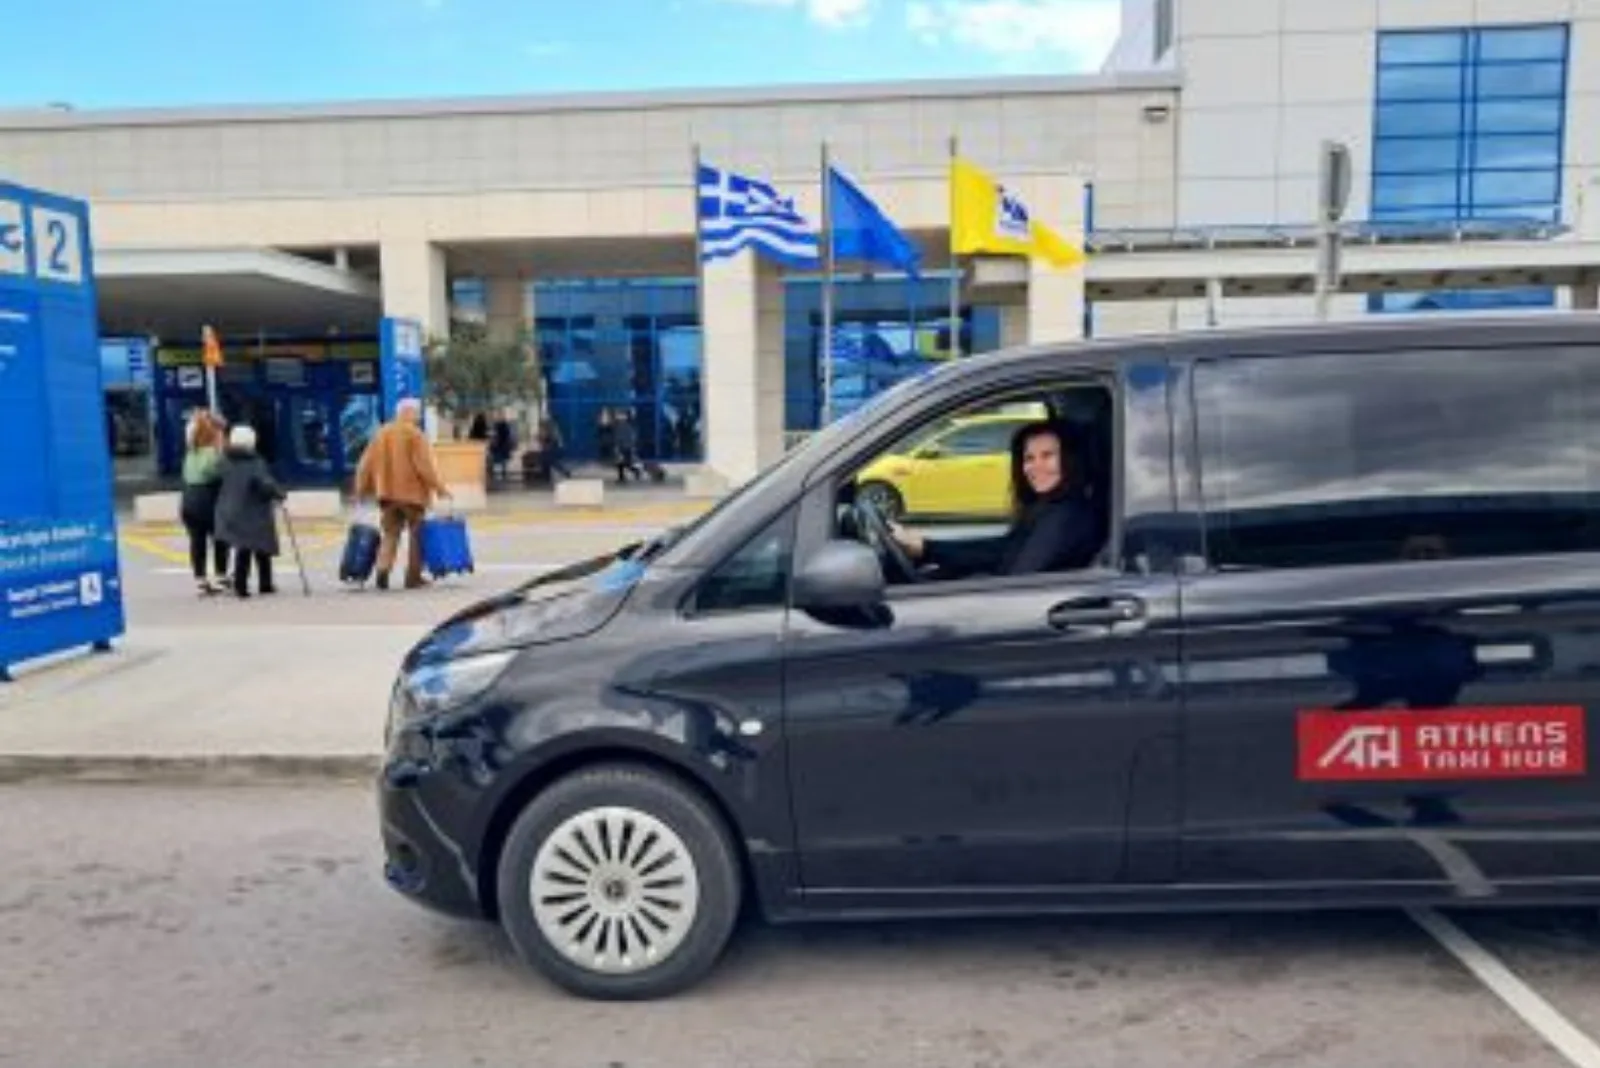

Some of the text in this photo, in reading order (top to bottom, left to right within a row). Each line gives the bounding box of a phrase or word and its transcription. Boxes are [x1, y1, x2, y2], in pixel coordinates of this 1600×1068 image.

[47, 218, 69, 274] 2
[1417, 721, 1567, 749] ATHENS
[1421, 749, 1567, 769] TAXI HUB
